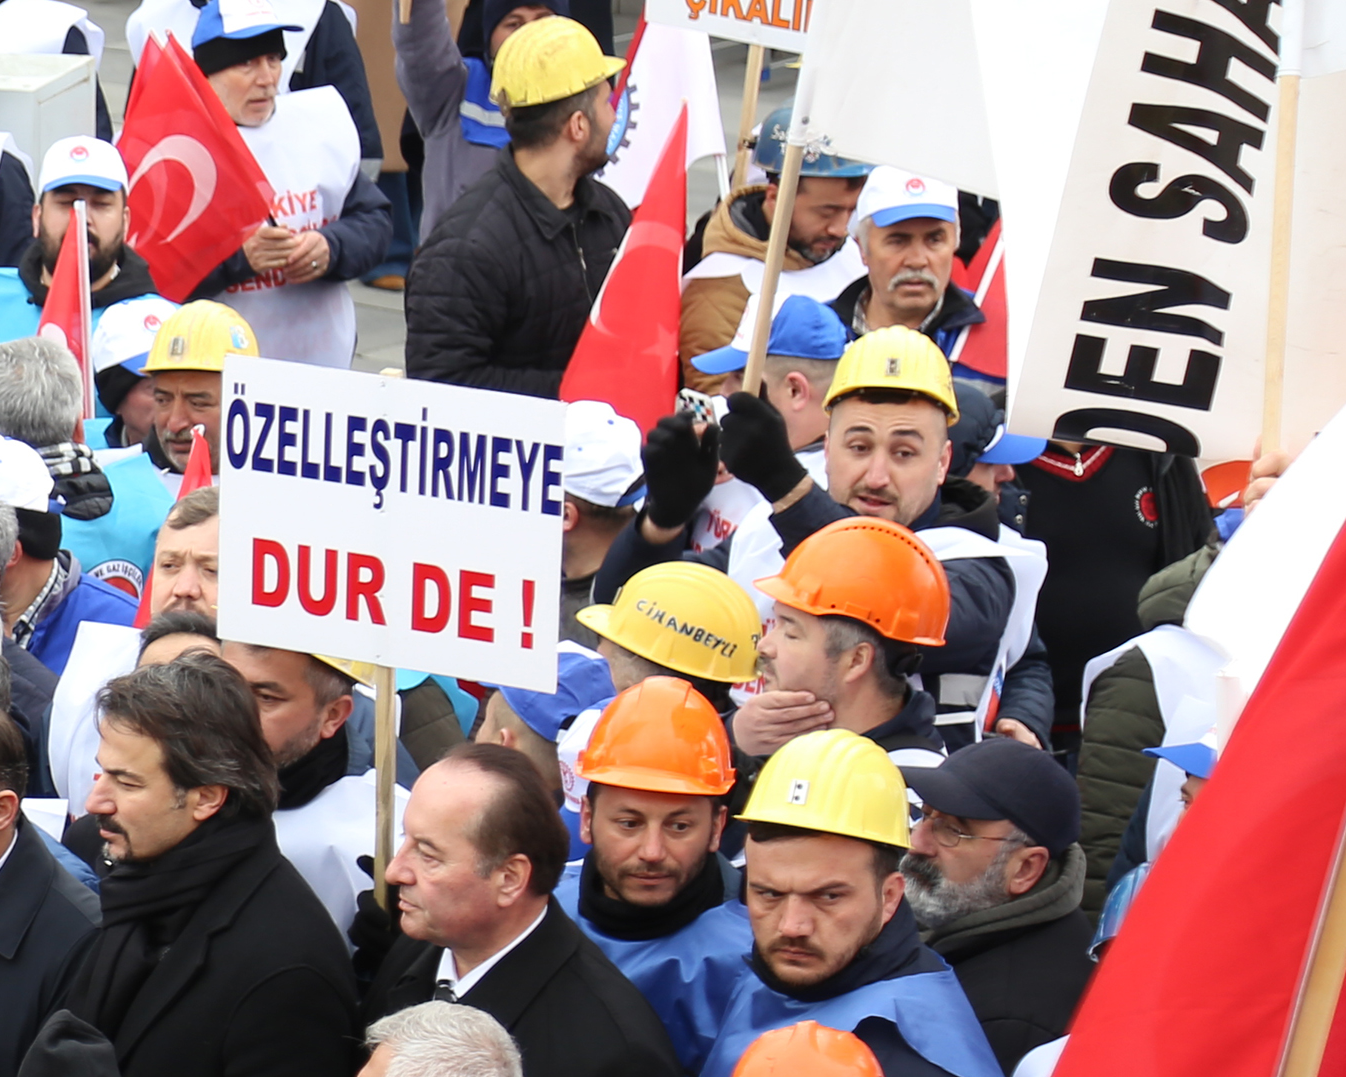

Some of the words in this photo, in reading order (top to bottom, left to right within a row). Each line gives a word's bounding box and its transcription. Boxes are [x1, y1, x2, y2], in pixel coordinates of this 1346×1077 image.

[272, 189, 318, 218] KİYE
[226, 384, 564, 515] ÖZELLEŞTİRMEYE
[251, 537, 386, 626] DUR
[411, 562, 495, 643] DE
